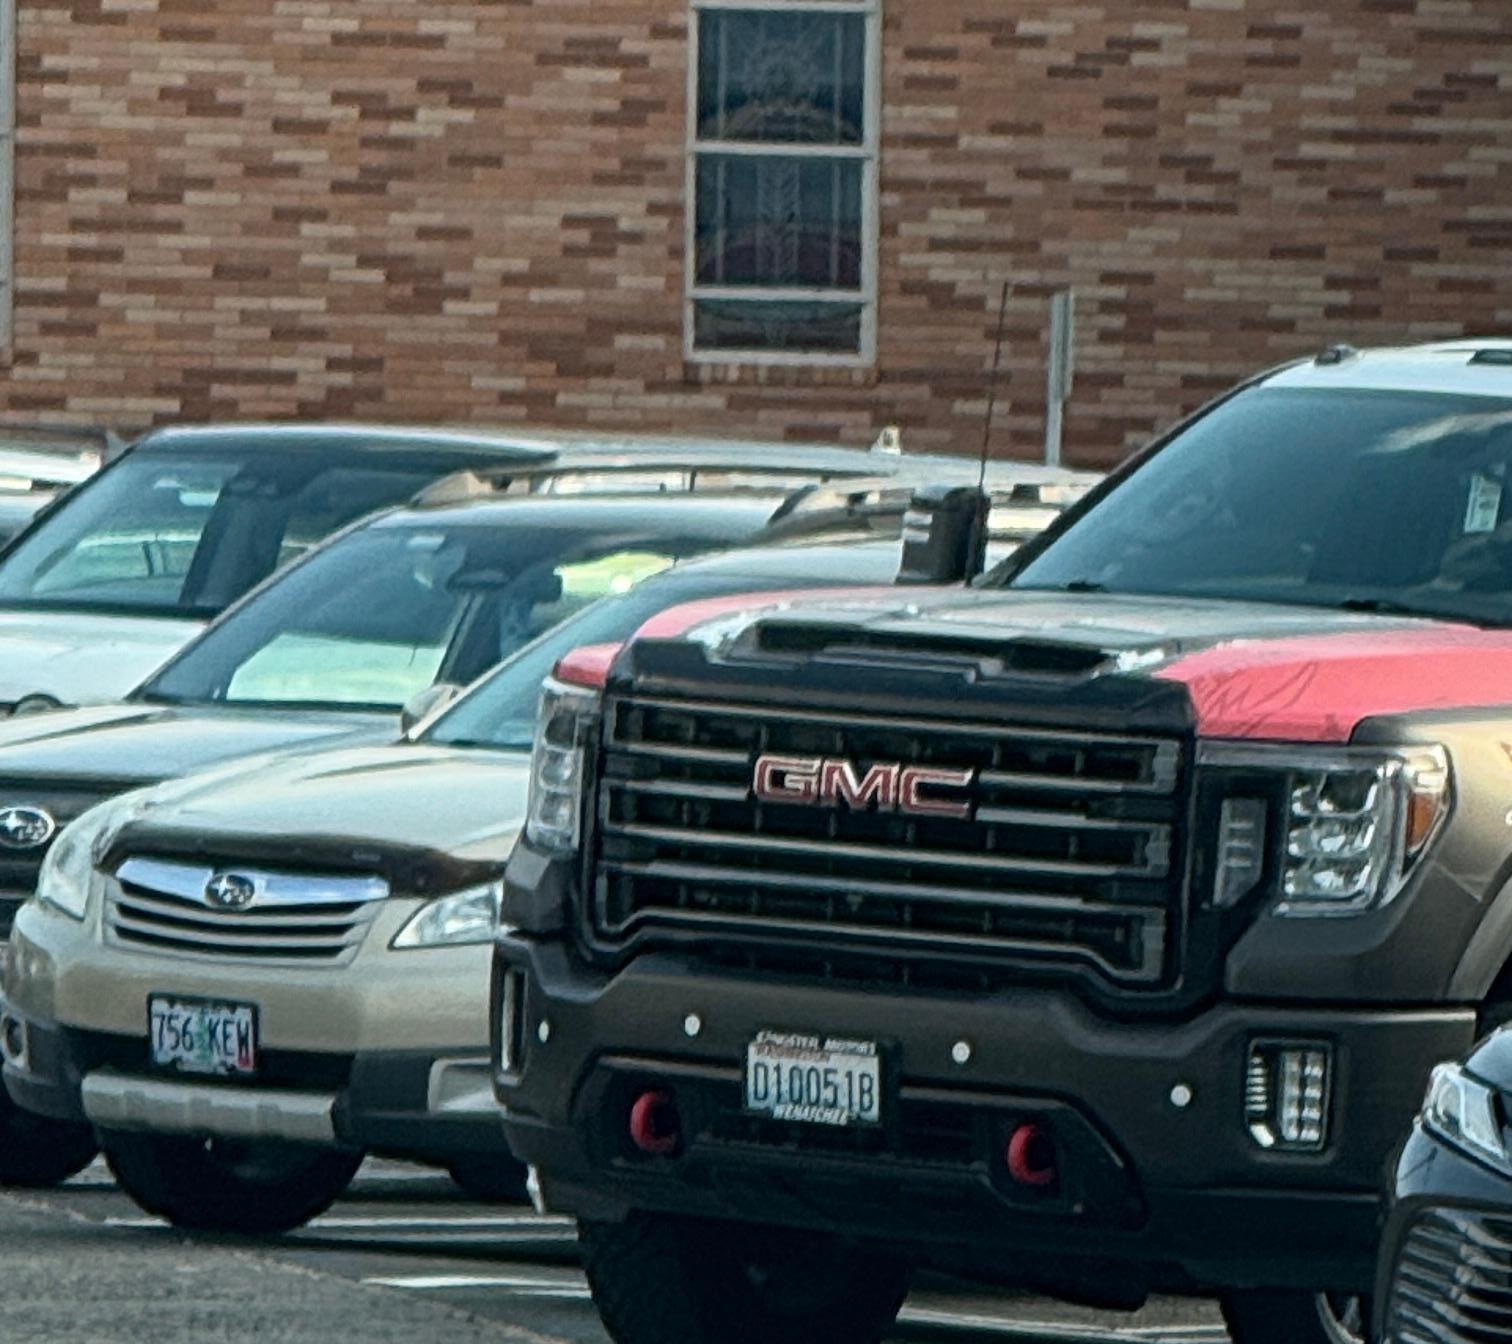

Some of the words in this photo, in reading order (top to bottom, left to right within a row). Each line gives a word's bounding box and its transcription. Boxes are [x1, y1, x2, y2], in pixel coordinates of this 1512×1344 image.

[753, 754, 974, 819] GMC
[153, 1013, 195, 1052] 756
[753, 1062, 874, 1113] D10051B
